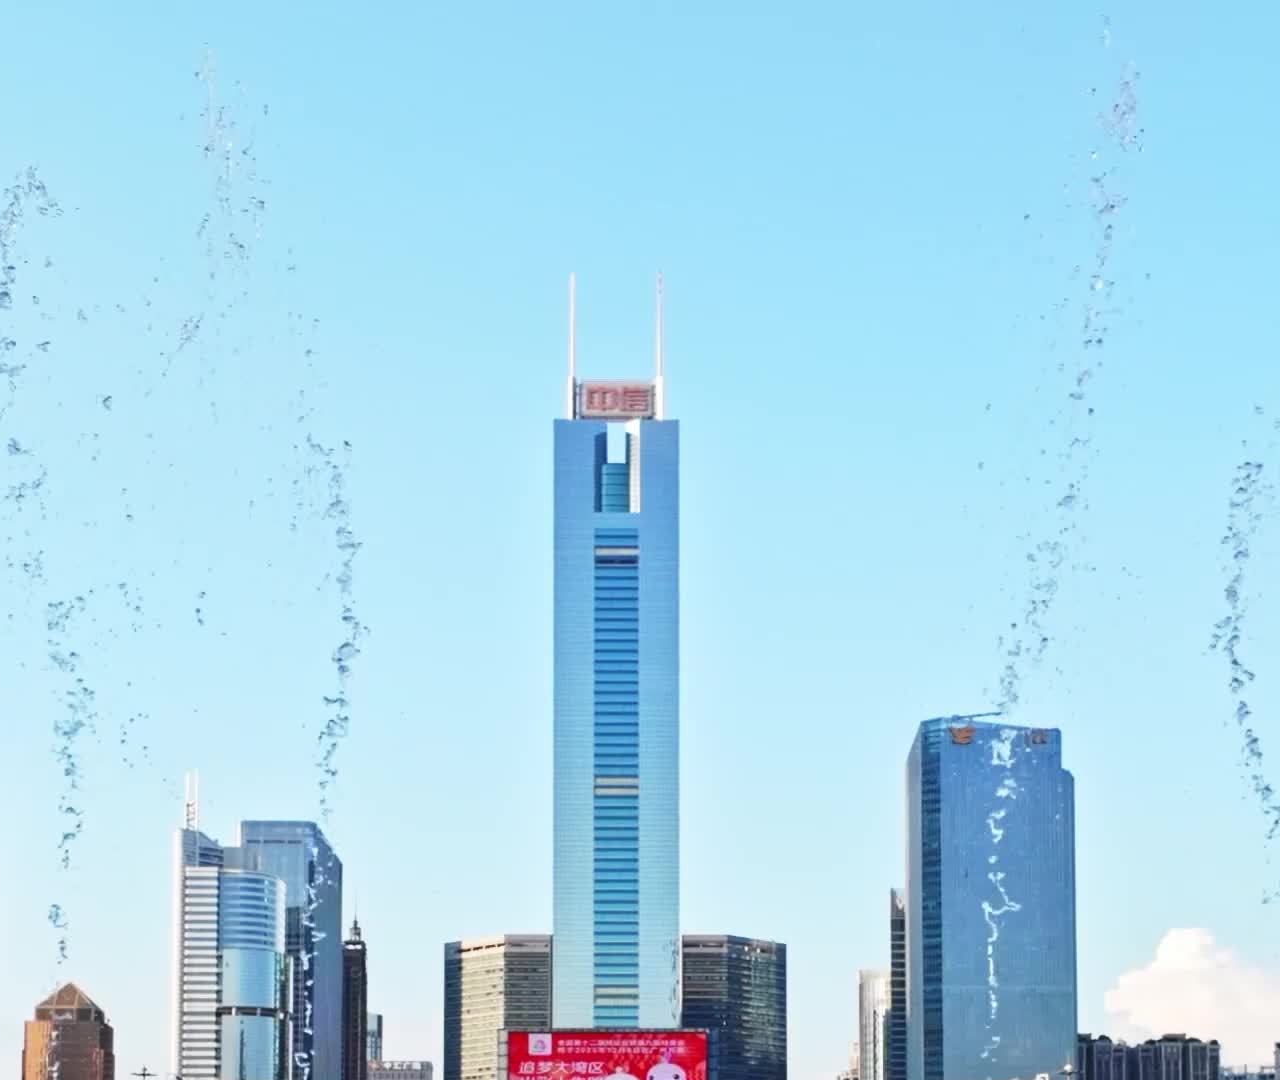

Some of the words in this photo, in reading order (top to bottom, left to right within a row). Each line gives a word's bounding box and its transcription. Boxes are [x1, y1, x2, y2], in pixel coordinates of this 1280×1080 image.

[518, 1061, 605, 1075] 追梦大湾区
